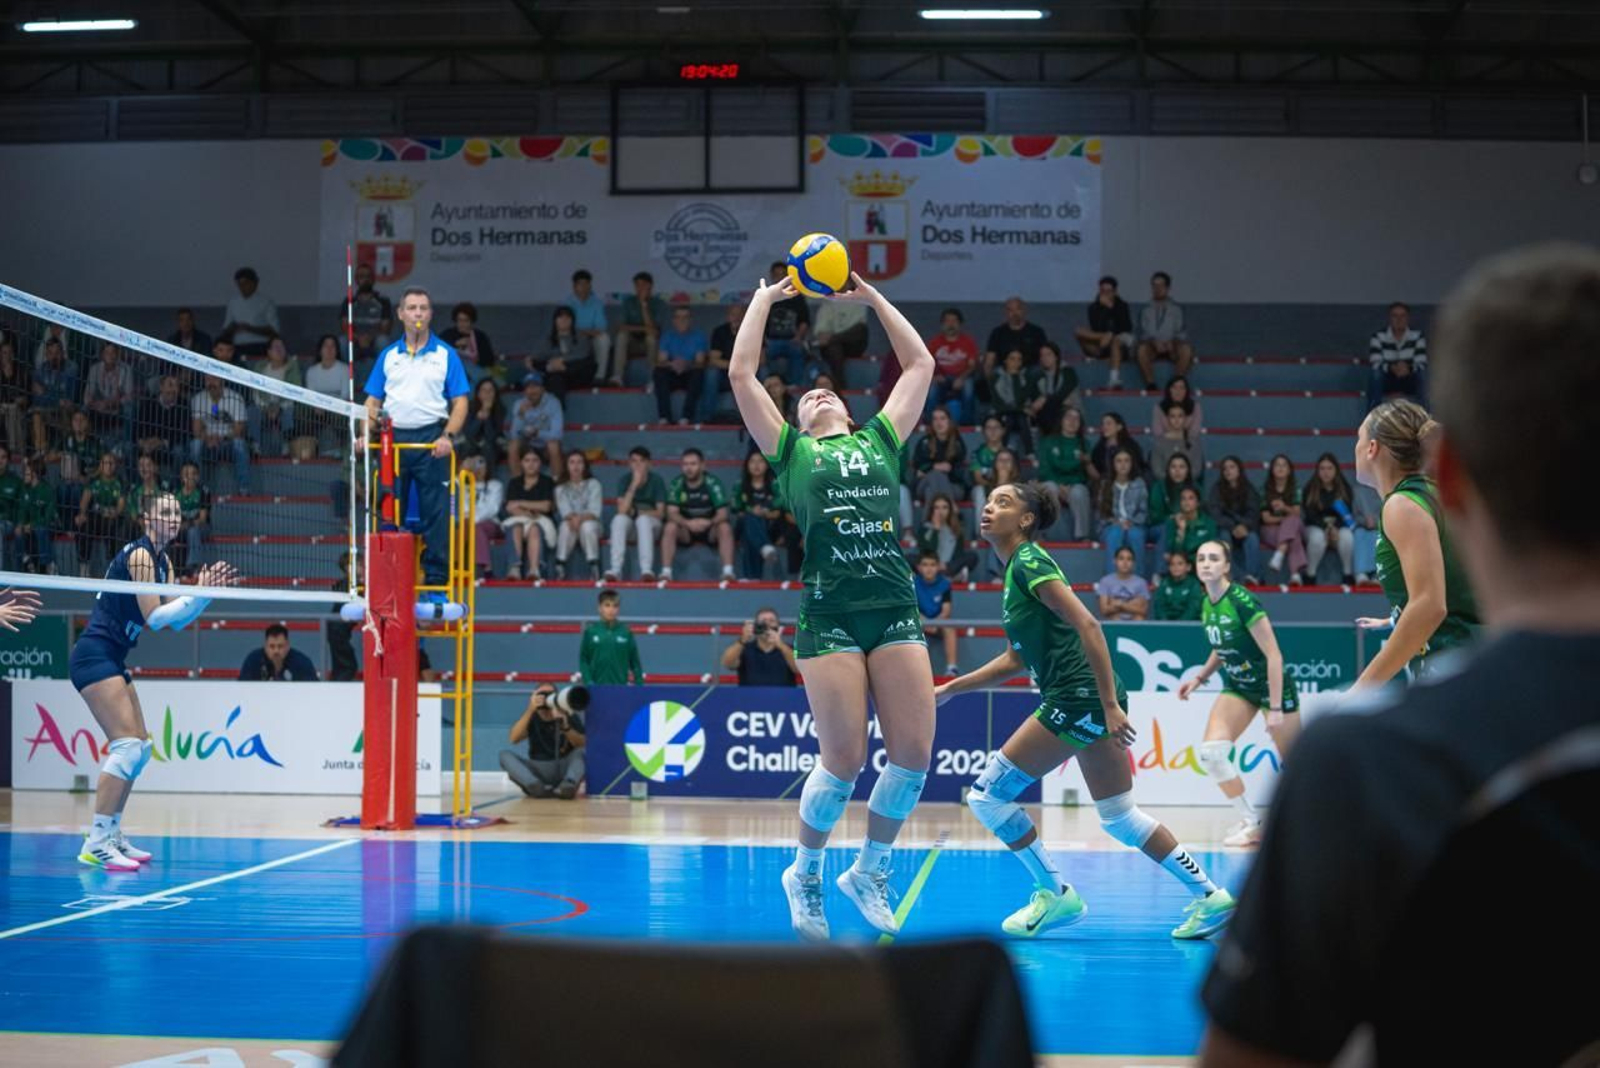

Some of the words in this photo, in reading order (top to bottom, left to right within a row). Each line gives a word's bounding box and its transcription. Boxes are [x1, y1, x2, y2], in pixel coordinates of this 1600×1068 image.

[430, 202, 558, 224] Ayuntamiento
[563, 202, 588, 220] de
[921, 200, 1051, 222] Ayuntamiento
[1056, 201, 1081, 219] de
[431, 227, 472, 246] Dos
[479, 227, 588, 246] Hermanas
[921, 225, 965, 244] Dos
[971, 226, 1081, 245] Hermanas
[831, 450, 870, 478] 14
[827, 485, 890, 499] Fundación
[837, 516, 893, 538] Cajasol
[1205, 625, 1222, 645] 10
[1284, 659, 1341, 678] ación
[726, 711, 786, 737] CEV
[1050, 708, 1067, 725] 15
[24, 702, 285, 768] Anlucía
[322, 760, 355, 770] Junta
[726, 744, 821, 772] Challe
